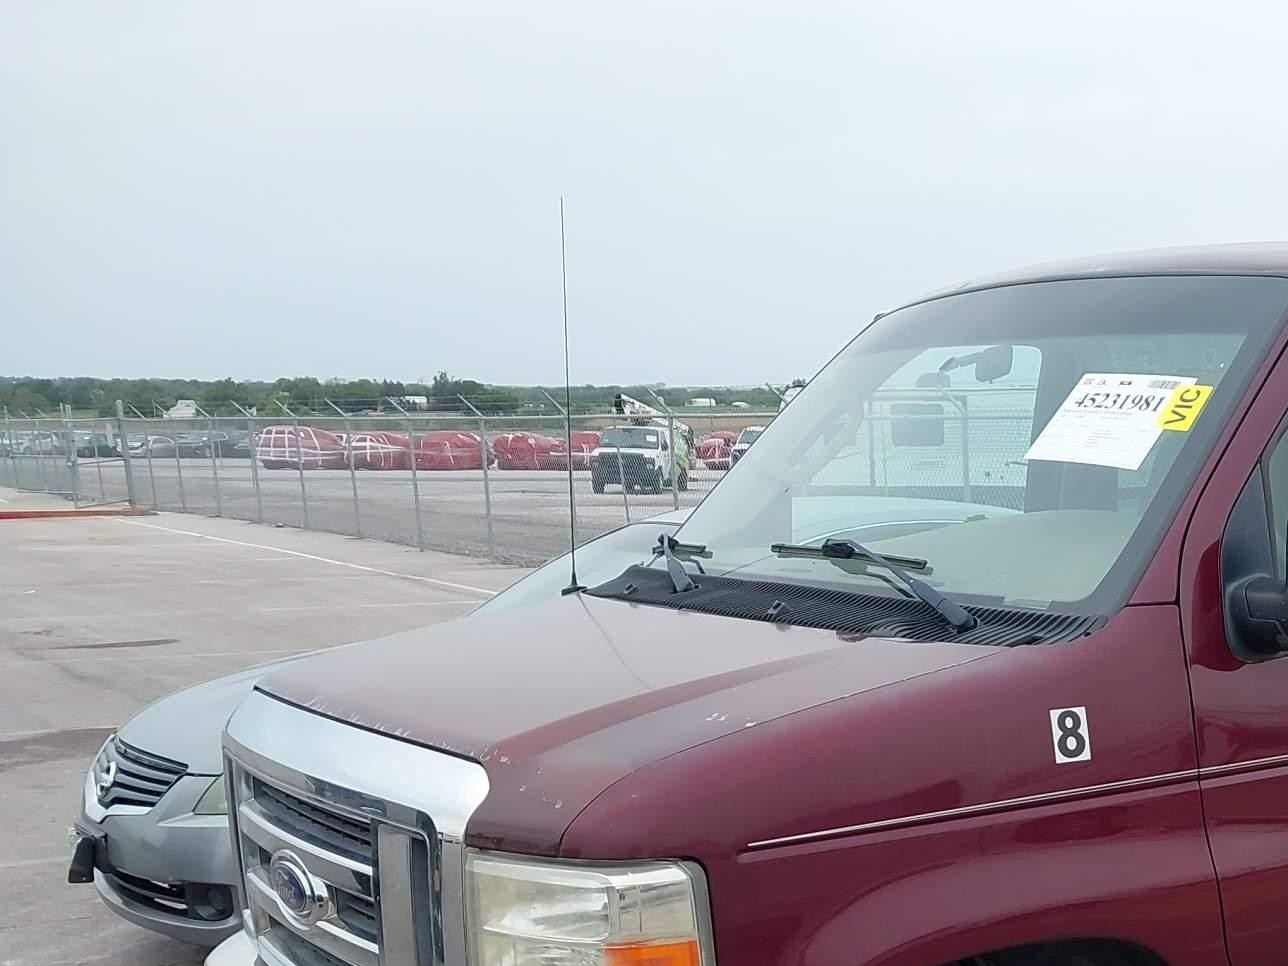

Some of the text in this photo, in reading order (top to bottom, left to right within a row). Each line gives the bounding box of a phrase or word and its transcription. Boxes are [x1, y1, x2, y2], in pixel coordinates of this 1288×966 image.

[1074, 392, 1167, 413] 45231981
[1163, 388, 1202, 426] VIC
[1057, 709, 1086, 758] 8
